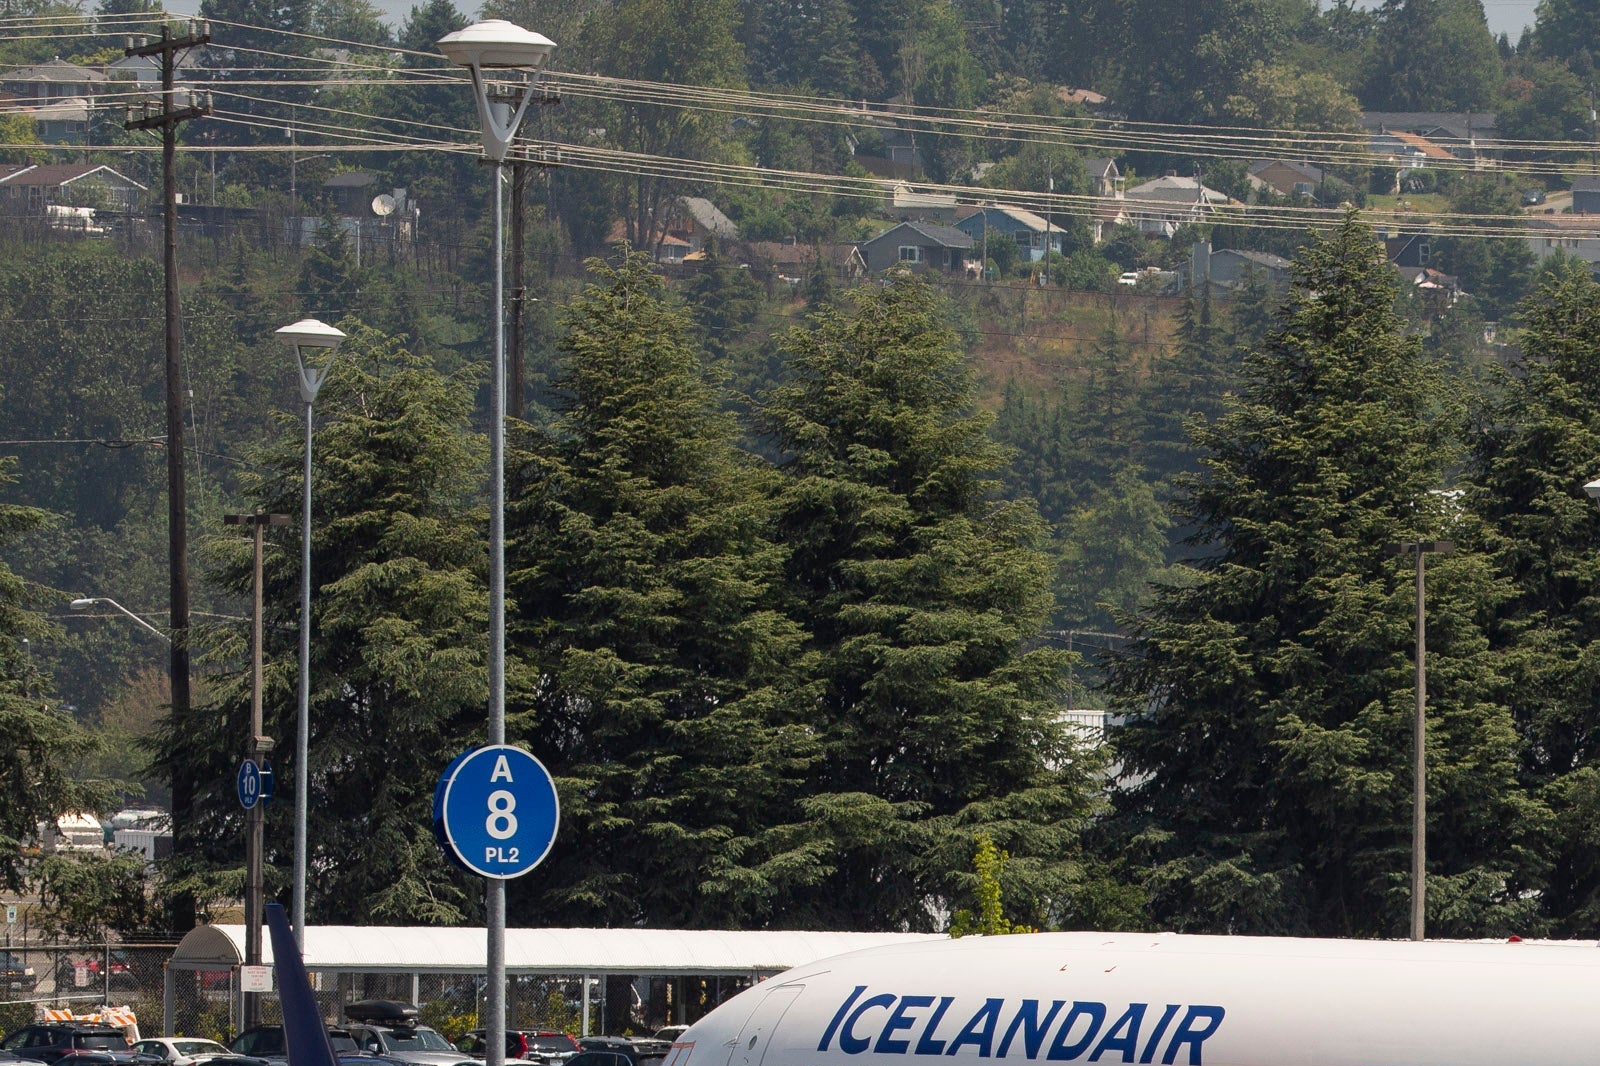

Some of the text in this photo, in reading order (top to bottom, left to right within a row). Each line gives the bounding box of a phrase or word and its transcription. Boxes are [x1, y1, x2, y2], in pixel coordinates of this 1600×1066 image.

[246, 762, 252, 774] B
[489, 754, 514, 783] A
[243, 775, 256, 796] 10
[485, 789, 519, 840] 8
[485, 846, 520, 863] PL2
[816, 985, 1227, 1066] ICELANDAIR
